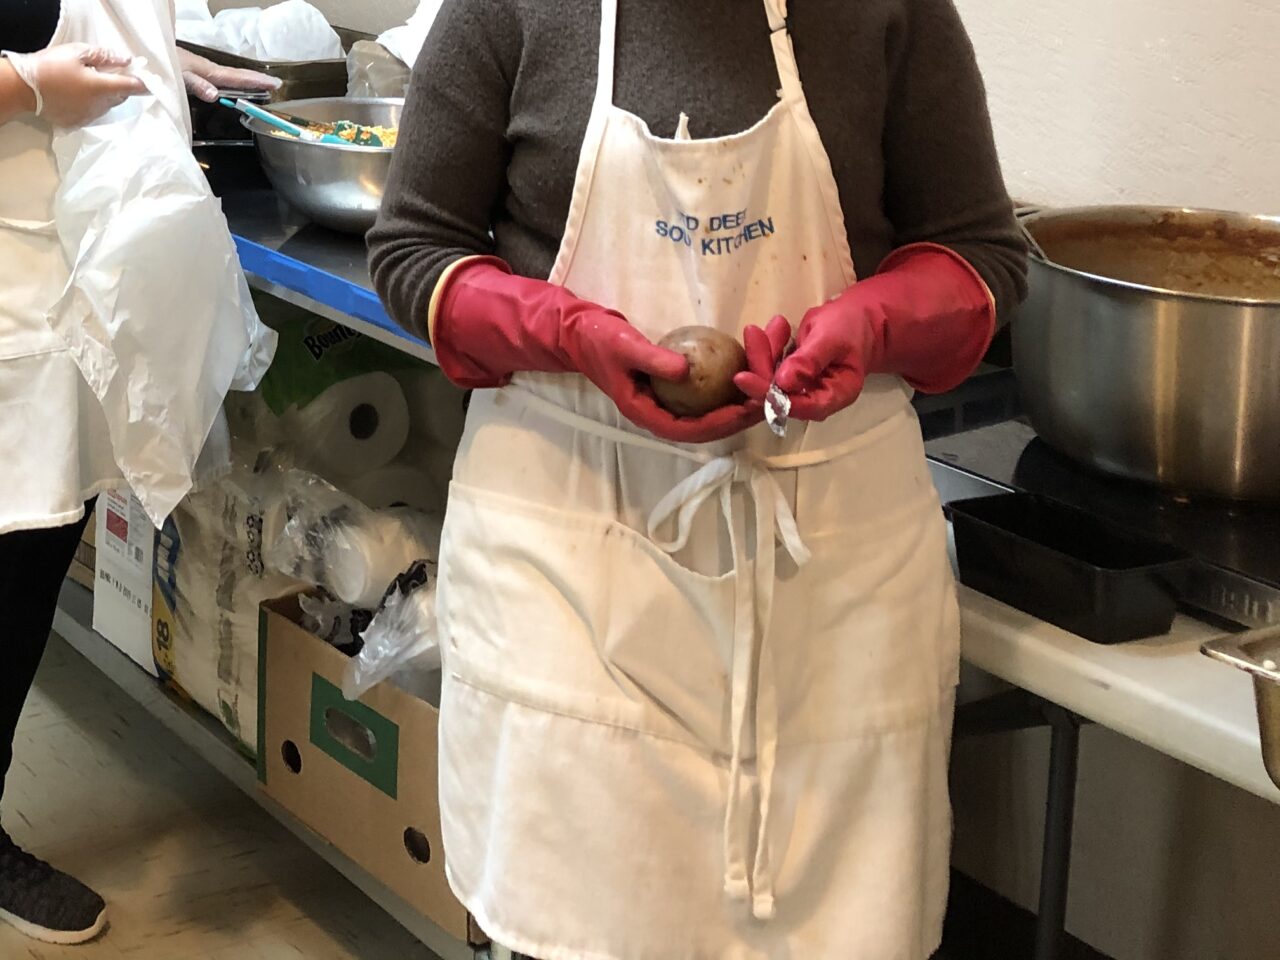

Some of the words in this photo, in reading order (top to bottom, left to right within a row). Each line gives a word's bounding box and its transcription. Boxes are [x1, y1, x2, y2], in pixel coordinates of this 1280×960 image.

[656, 220, 692, 246] SOU
[304, 324, 362, 361] Bount
[156, 618, 170, 652] 18
